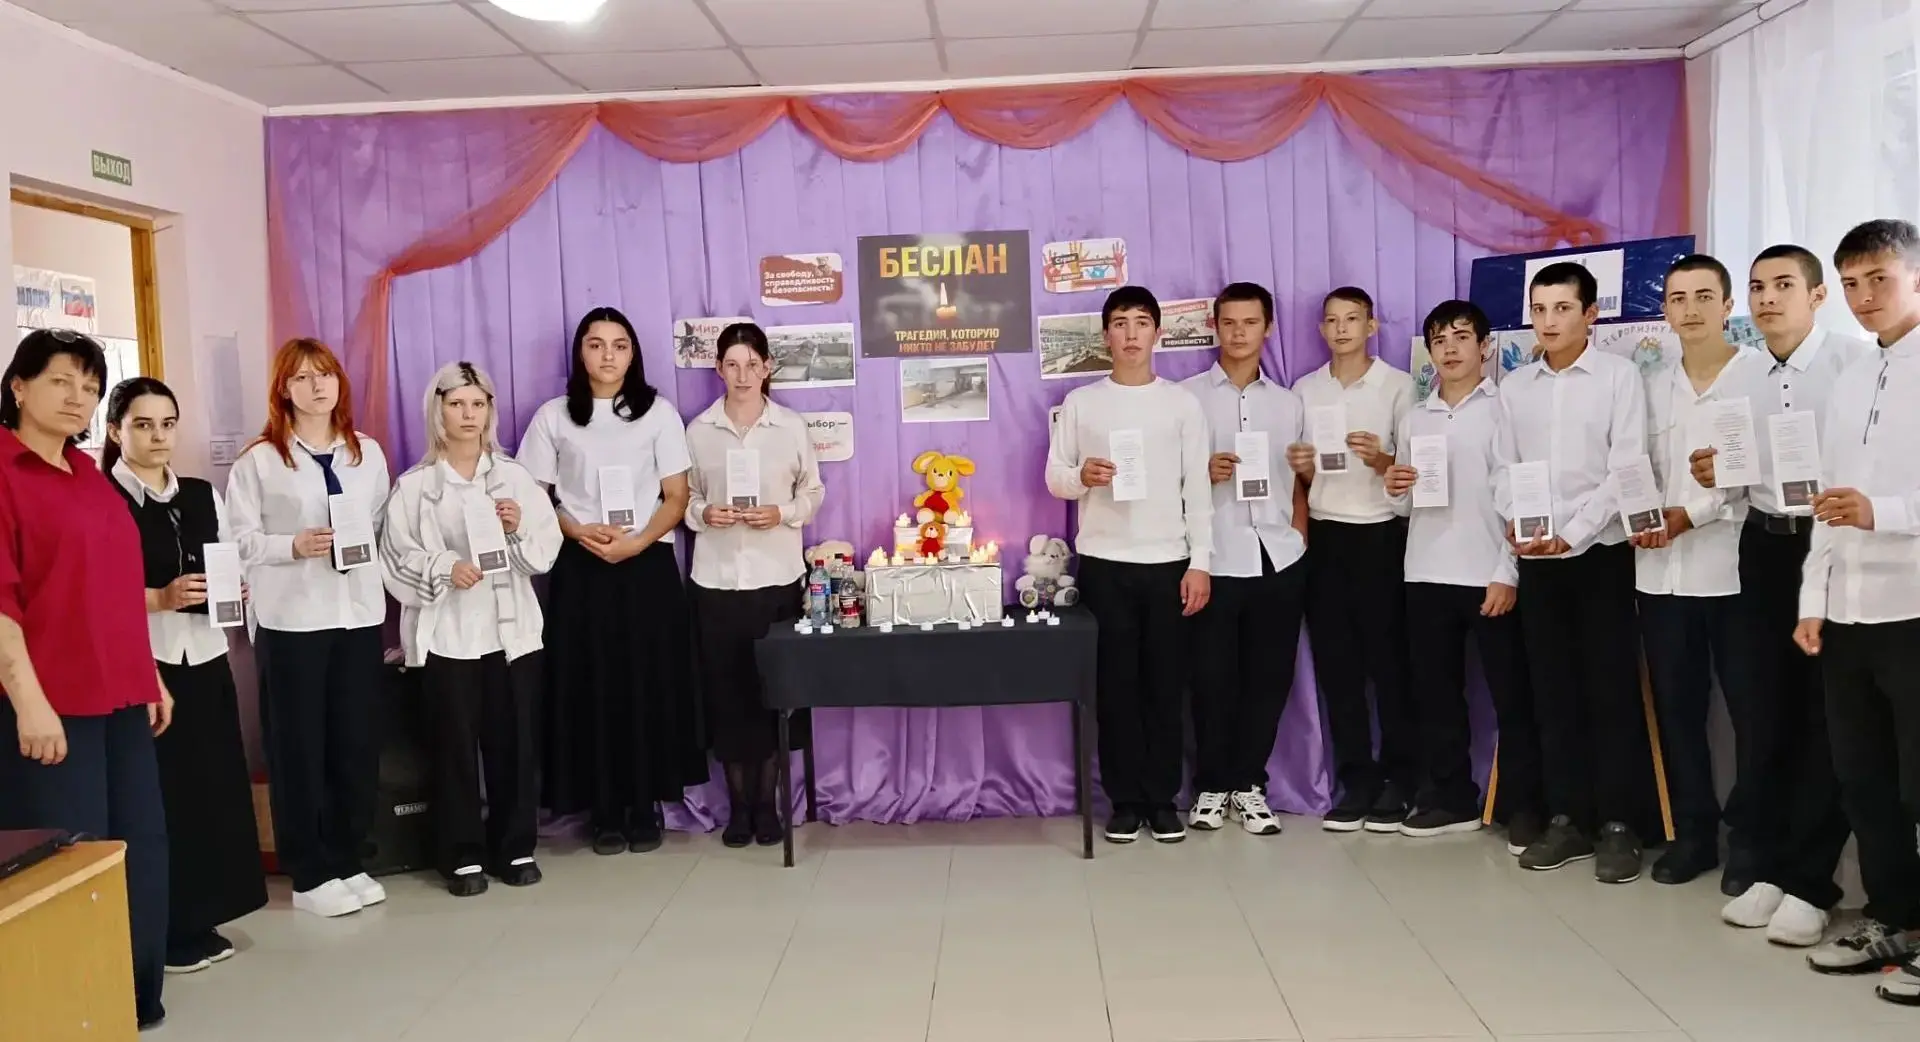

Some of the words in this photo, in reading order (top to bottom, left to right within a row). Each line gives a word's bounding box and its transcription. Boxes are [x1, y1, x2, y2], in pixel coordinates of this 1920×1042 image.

[93, 154, 131, 183] ВЫХОД
[879, 243, 1008, 278] БЕСЛАН
[764, 271, 775, 279] За
[776, 269, 815, 279] свободу,
[764, 277, 836, 287] справедливость
[772, 284, 834, 294] безопасность!
[895, 329, 949, 342] ТРАГЕДИЯ,
[951, 327, 1000, 339] КОТОРУЮ
[898, 341, 933, 353] НИКТО
[934, 341, 948, 352] НЕ
[949, 339, 996, 352] ЗАБУДЕТ
[807, 419, 836, 429] ыбор
